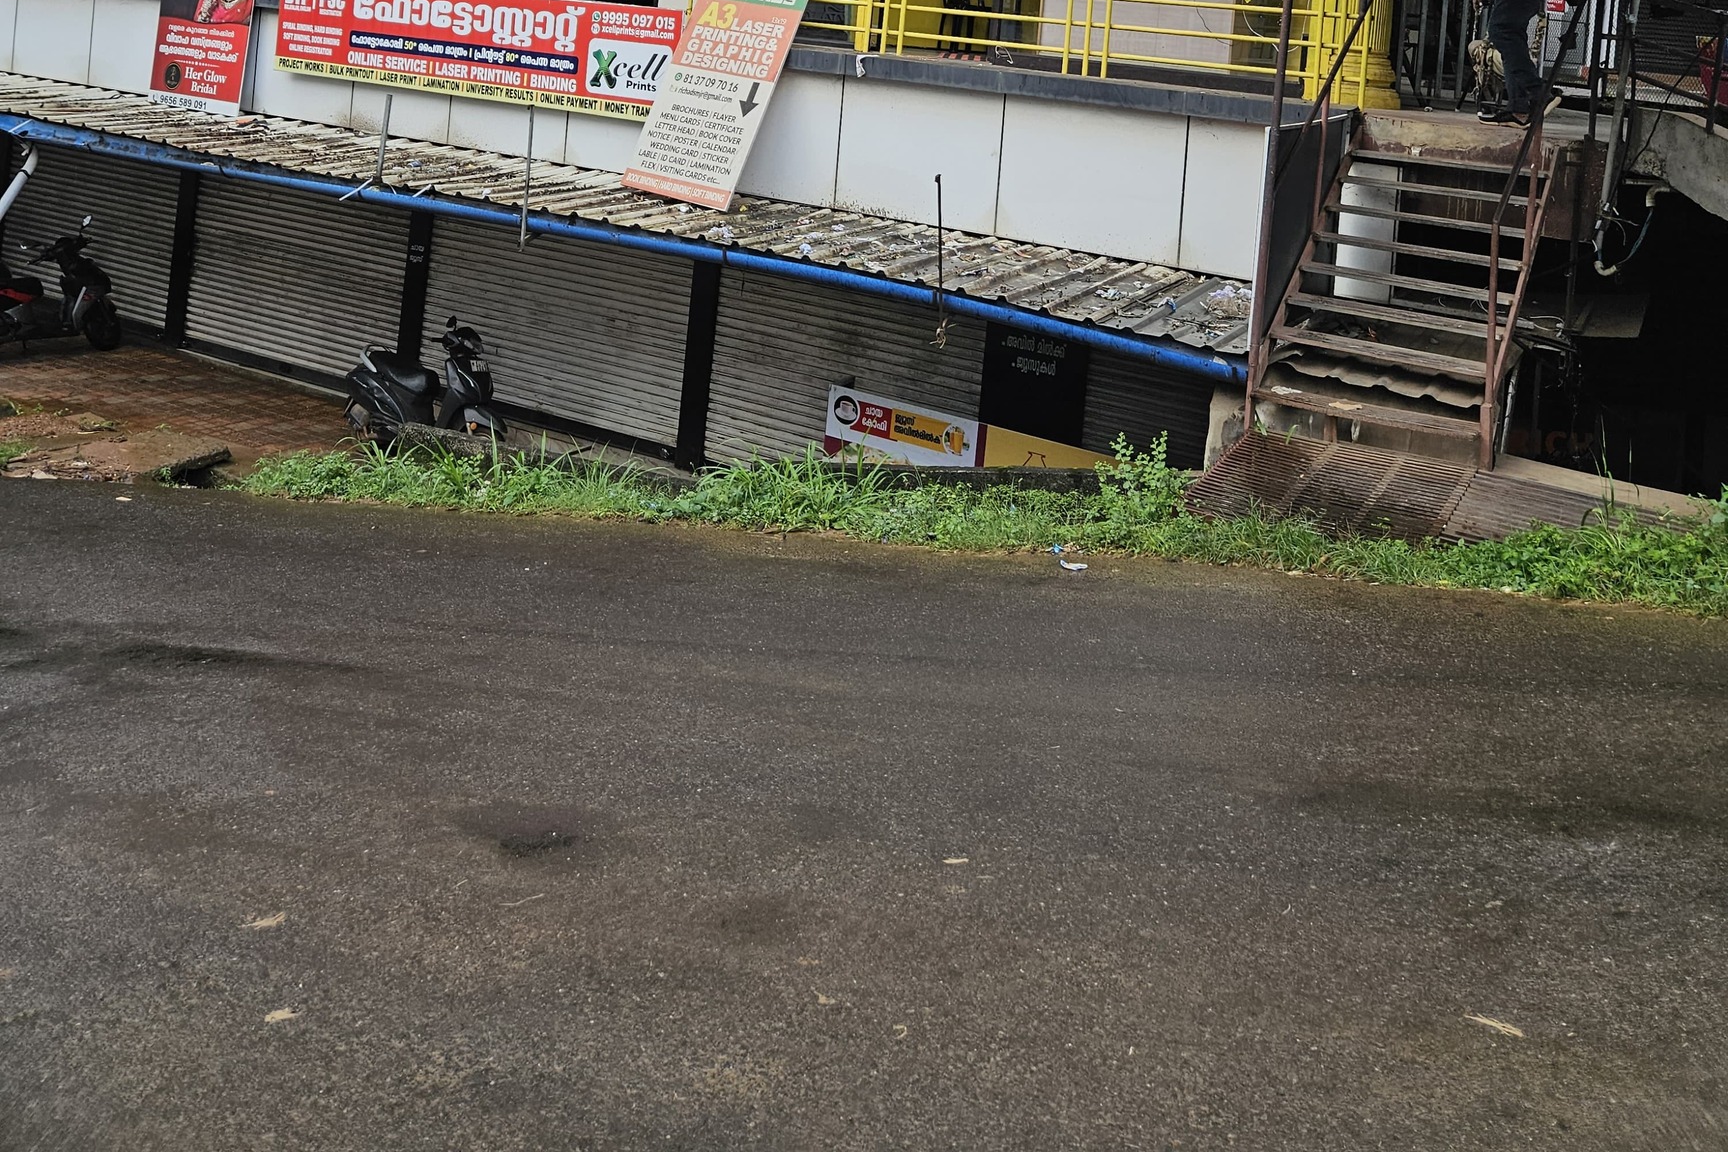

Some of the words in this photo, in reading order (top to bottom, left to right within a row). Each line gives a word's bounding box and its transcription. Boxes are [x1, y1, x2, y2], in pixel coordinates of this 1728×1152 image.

[601, 11, 629, 25] 9995
[631, 13, 654, 28] 097
[655, 16, 676, 30] 015
[696, 1, 737, 29] A3
[731, 18, 785, 38] LASER
[601, 25, 675, 40] xcellprints@gmail.com
[184, 66, 202, 80] Her
[203, 69, 227, 84] Glow
[347, 51, 384, 67] ONLINE
[385, 54, 428, 73] SERVICE
[435, 61, 468, 78] LASER
[470, 65, 521, 86] PRINTING
[530, 73, 577, 93] BINDING
[589, 49, 668, 89] Xcell
[680, 51, 769, 78] DESIGNING
[190, 81, 217, 95] Bridal
[278, 58, 304, 69] PROJECT
[304, 61, 324, 72] WORKS
[329, 65, 345, 76] BULK
[345, 67, 375, 80] PRINTOUT
[379, 71, 398, 83] LASER
[399, 74, 418, 85] PRINT
[422, 78, 460, 91] LAMINATION
[465, 82, 504, 97] UNIVERSITY
[504, 87, 534, 102] RESULTS
[540, 92, 565, 105] ONLINE
[566, 96, 598, 111] PAYMENT
[604, 101, 630, 115] MONEY
[626, 79, 657, 92] Prints
[683, 73, 694, 84] 81
[694, 76, 706, 86] 37
[705, 78, 716, 88] 09
[716, 79, 728, 90] 70
[728, 82, 739, 93] 16
[160, 94, 177, 105] 9656
[179, 96, 192, 108] 589
[193, 100, 207, 110] 091
[671, 103, 710, 118] BROCHURES
[712, 112, 737, 123] FLAYER
[654, 121, 677, 132] LETTER
[677, 125, 696, 136] HEAD
[698, 130, 718, 141] BOOK
[718, 134, 742, 145] COVER
[659, 112, 680, 122] MENU
[680, 115, 701, 127] CARDS
[704, 121, 744, 135] CERTIFICATE
[647, 130, 671, 142] NOTICE
[673, 135, 699, 147] POSTER
[701, 141, 737, 155] CALENDAR
[649, 140, 680, 154] WEDDING
[680, 147, 699, 158] CARD
[702, 152, 729, 164] STICKER
[638, 149, 658, 160] LABLE
[660, 153, 668, 162] ID
[667, 155, 687, 166] CARD
[689, 160, 732, 176] LAMINATION
[640, 159, 657, 170] FLEX
[659, 163, 684, 176] VSITING
[684, 170, 707, 182] CARDS
